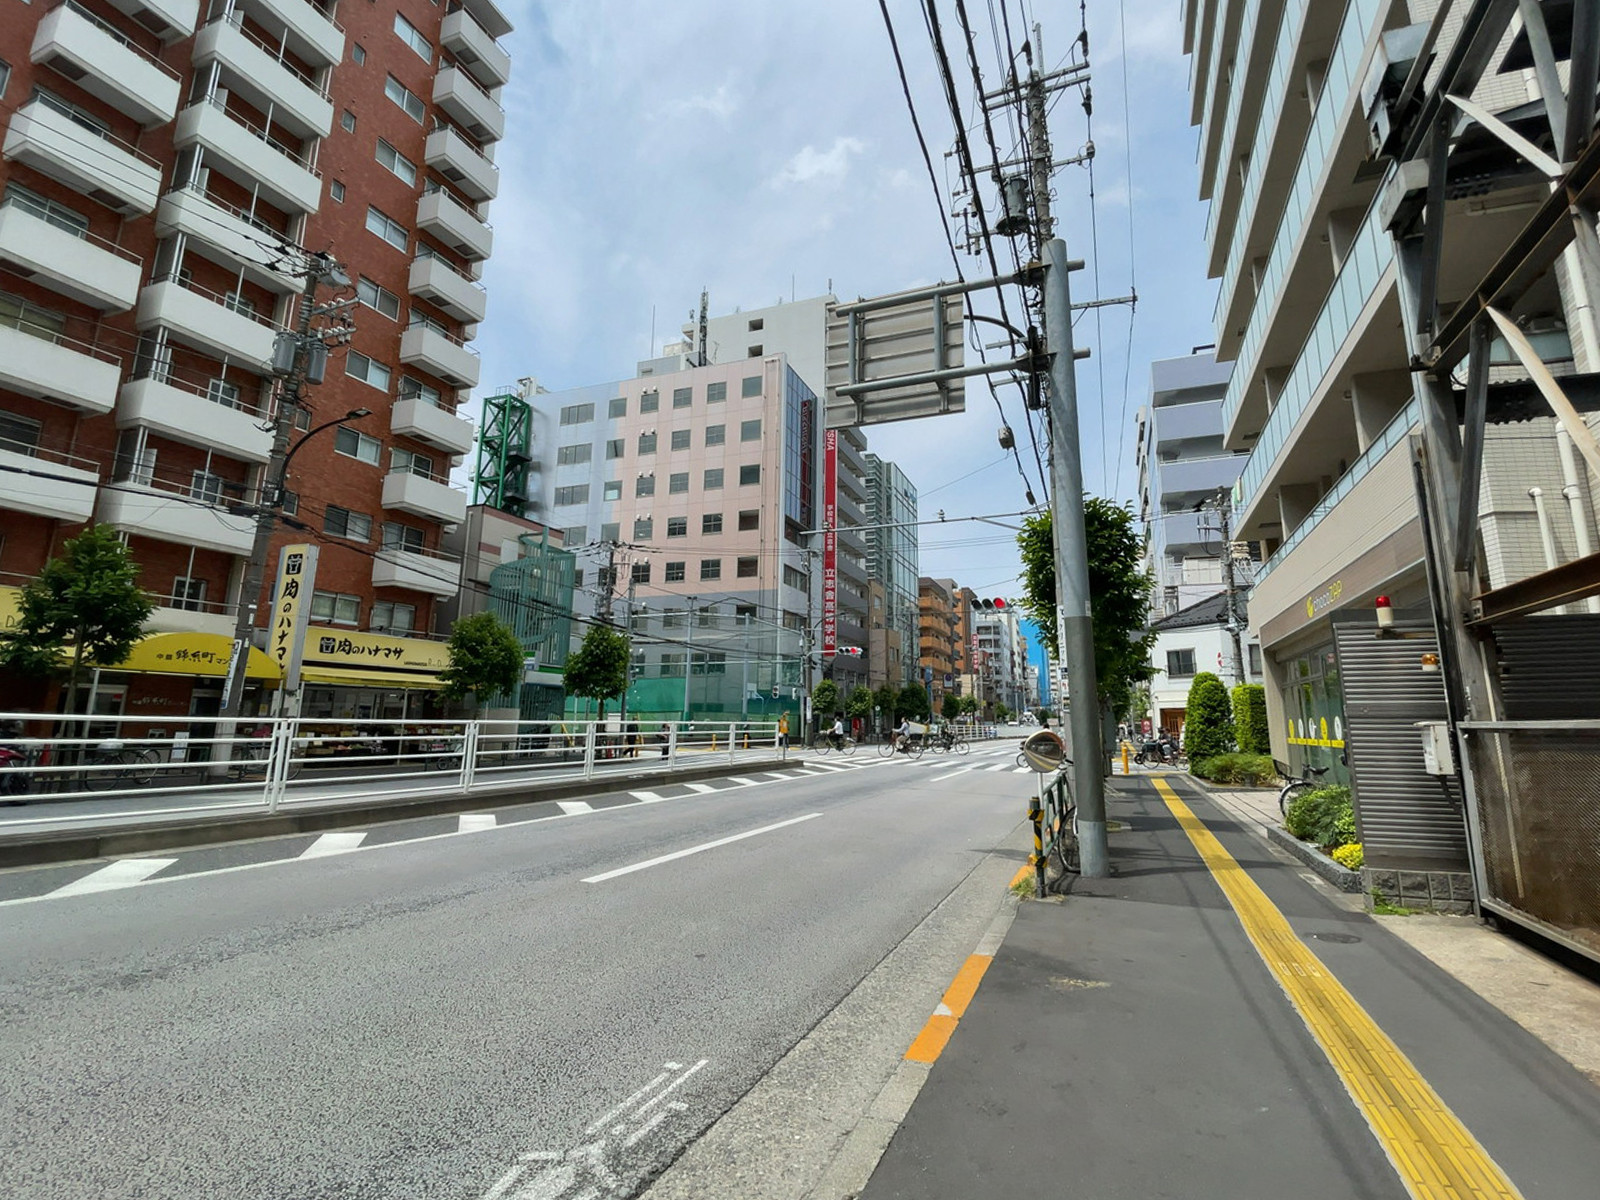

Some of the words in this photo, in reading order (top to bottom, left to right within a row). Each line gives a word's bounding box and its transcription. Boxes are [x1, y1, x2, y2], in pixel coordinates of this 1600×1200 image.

[336, 638, 404, 660] 肉のハナマサ
